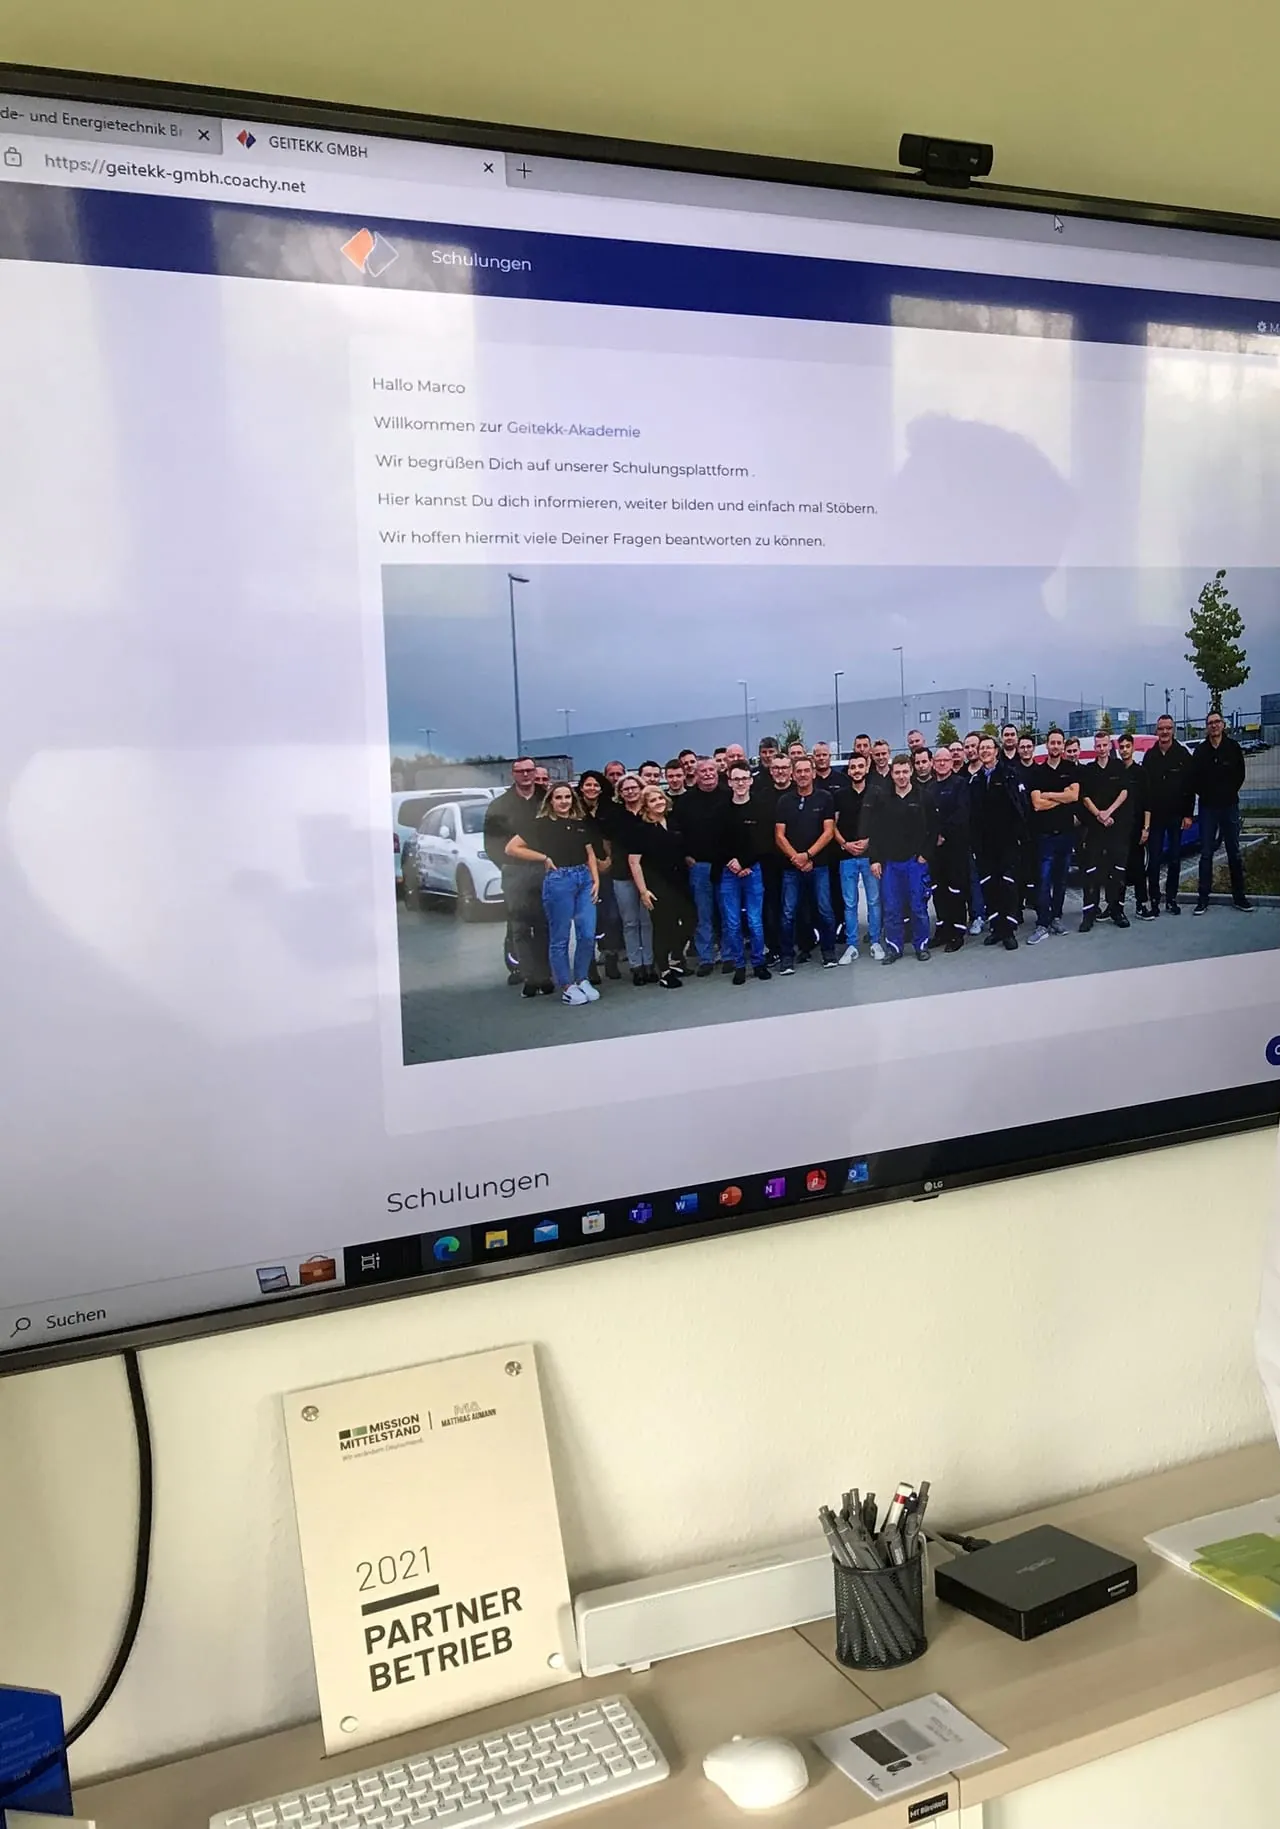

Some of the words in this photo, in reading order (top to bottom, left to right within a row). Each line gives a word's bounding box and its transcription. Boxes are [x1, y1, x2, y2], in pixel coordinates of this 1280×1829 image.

[30, 112, 57, 124] und
[62, 112, 167, 136] Energietechnik
[268, 134, 324, 154] GEITEKK
[326, 142, 368, 159] GMBH
[45, 153, 306, 196] https://geitekk-gmbh.coachy.net
[431, 250, 532, 274] Schulungen
[372, 378, 413, 393] Hallo
[417, 380, 466, 395] Marco
[374, 416, 475, 432] Willkommen
[480, 423, 503, 434] zur
[506, 421, 641, 438] Geitekk-Akademie
[376, 454, 403, 468] Wir
[408, 455, 484, 473] begrüßen
[489, 457, 523, 471] Dich
[526, 458, 551, 472] auf
[554, 462, 609, 473] unserer
[612, 460, 749, 479] Schulungsplattform
[378, 493, 409, 506] Hier
[415, 494, 467, 507] kannst
[472, 495, 494, 507] Du
[498, 495, 529, 508] dich
[534, 495, 621, 511] informieren,
[625, 498, 668, 511] weiter
[671, 498, 714, 512] bilden
[717, 499, 744, 512] und
[747, 499, 795, 513] einfach
[799, 501, 822, 513] mal
[826, 501, 878, 514] Stöbern.
[379, 530, 407, 543] Wir
[411, 530, 460, 544] hoffen
[465, 531, 520, 545] hiermit
[523, 532, 557, 545] viele
[561, 532, 609, 546] Deiner
[613, 532, 661, 549] Fragen
[665, 533, 752, 547] beantworten
[755, 537, 770, 547] zu
[774, 533, 825, 548] können.
[387, 1169, 550, 1215] Schulungen
[933, 1181, 943, 1189] LG
[45, 1306, 107, 1331] Suchen
[370, 1414, 419, 1434] MISSION
[441, 1414, 471, 1427] MATTHIAS
[471, 1409, 497, 1420] AUMANN
[340, 1424, 421, 1450] MITTELSTAND
[356, 1546, 431, 1591] 2021
[364, 1586, 522, 1654] PARTNER
[369, 1626, 513, 1692] BETRIEB
